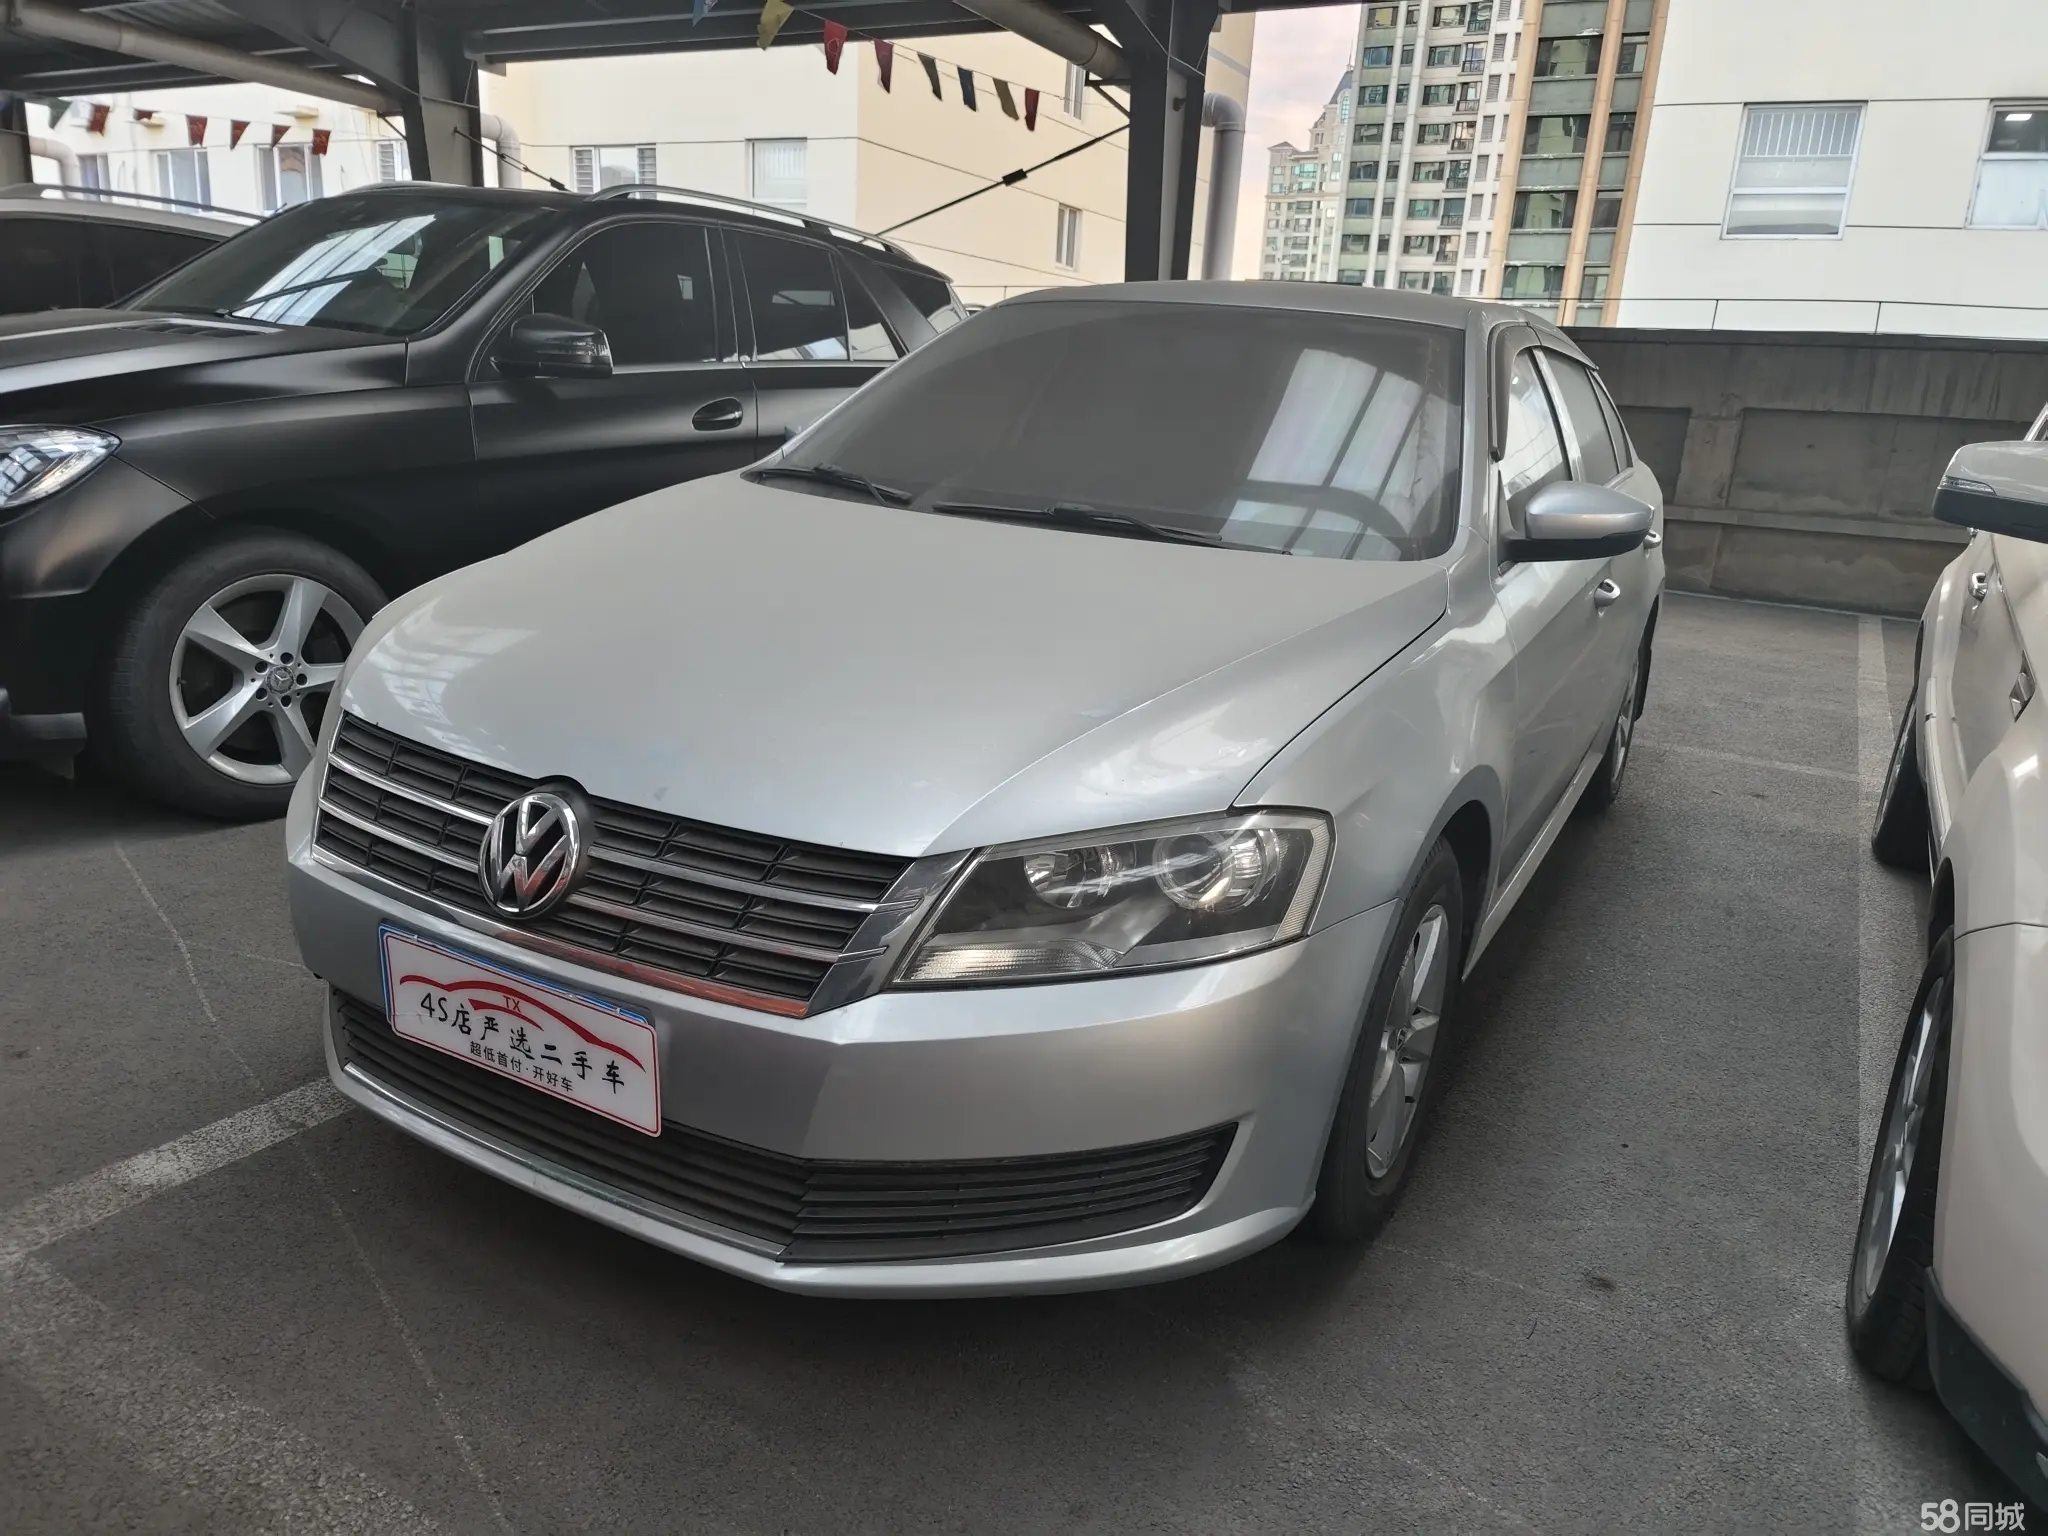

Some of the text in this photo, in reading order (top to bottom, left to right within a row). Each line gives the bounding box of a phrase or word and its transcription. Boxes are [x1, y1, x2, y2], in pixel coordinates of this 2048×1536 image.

[503, 995, 522, 1014] TX
[420, 992, 625, 1094] 4S店严选二手车
